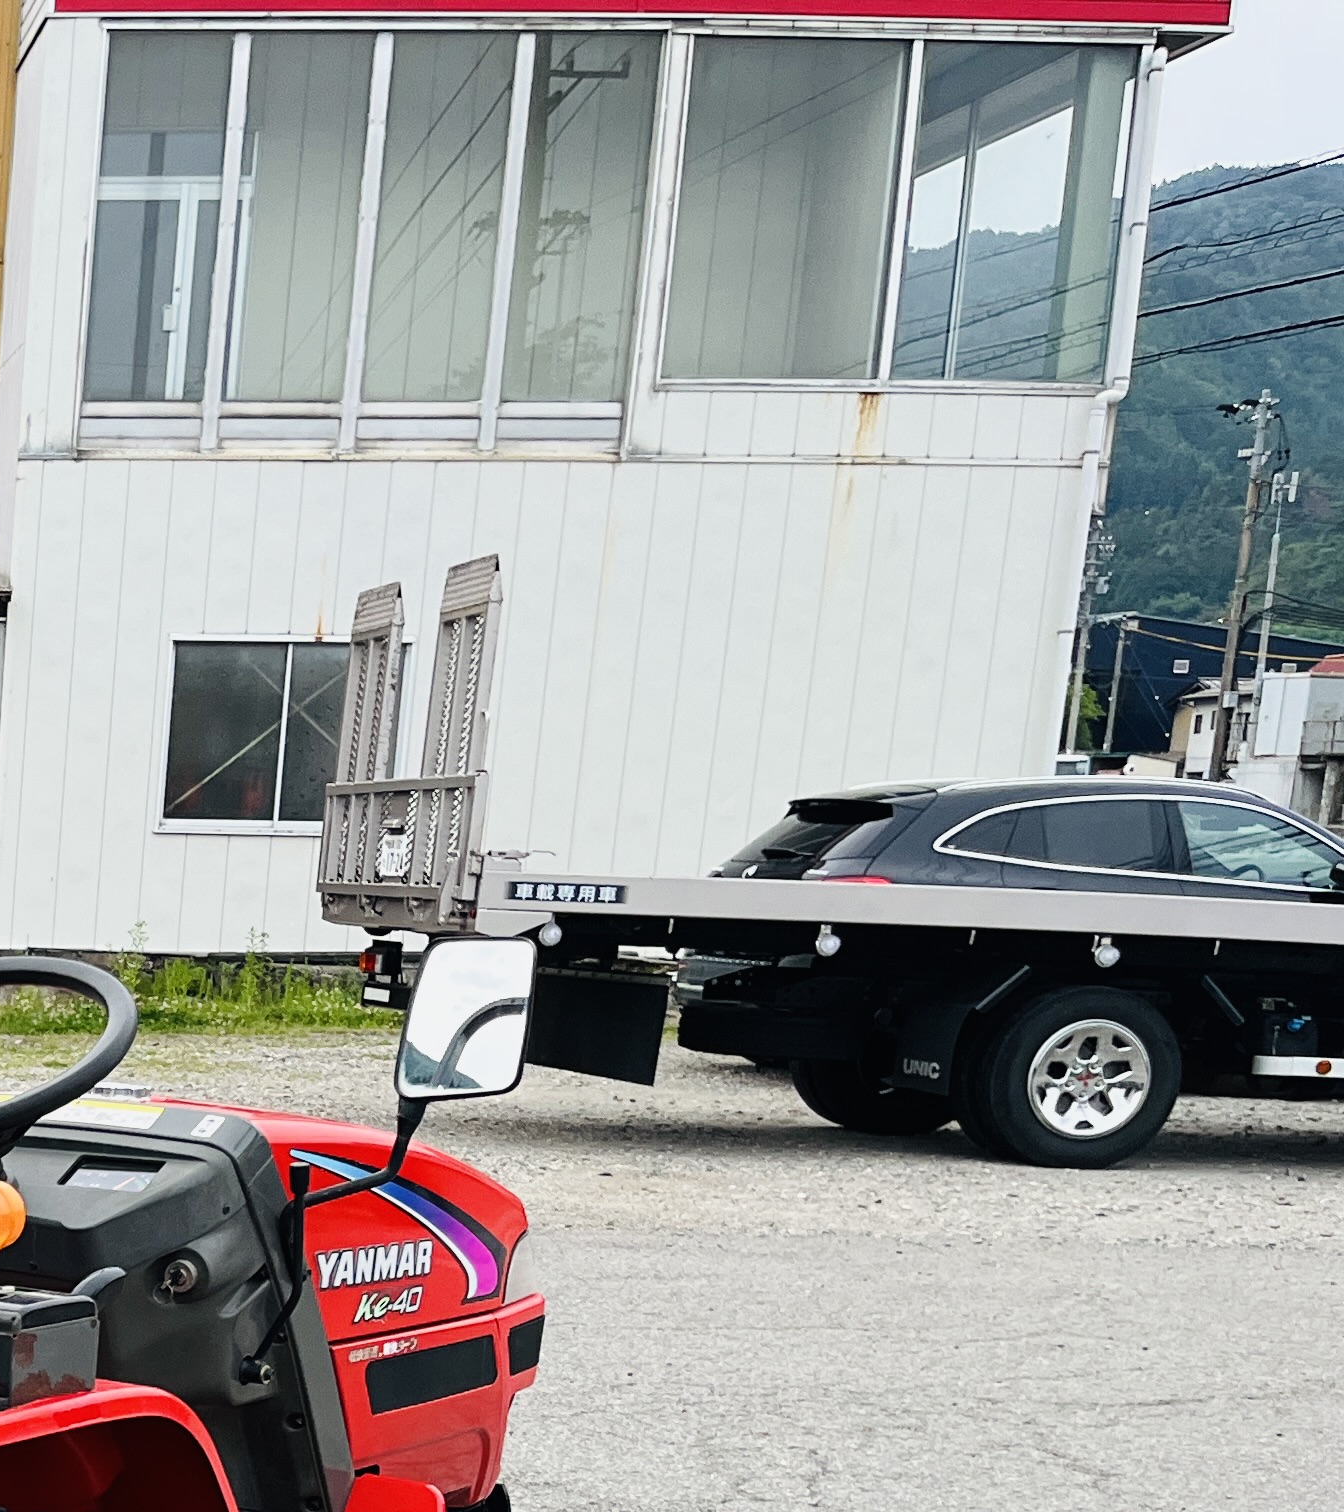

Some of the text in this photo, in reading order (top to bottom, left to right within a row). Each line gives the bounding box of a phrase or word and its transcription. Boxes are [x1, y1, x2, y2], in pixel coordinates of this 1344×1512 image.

[903, 1058, 940, 1079] UNIC
[316, 1240, 433, 1290] YANMAR
[353, 1285, 423, 1323] Ke-40
